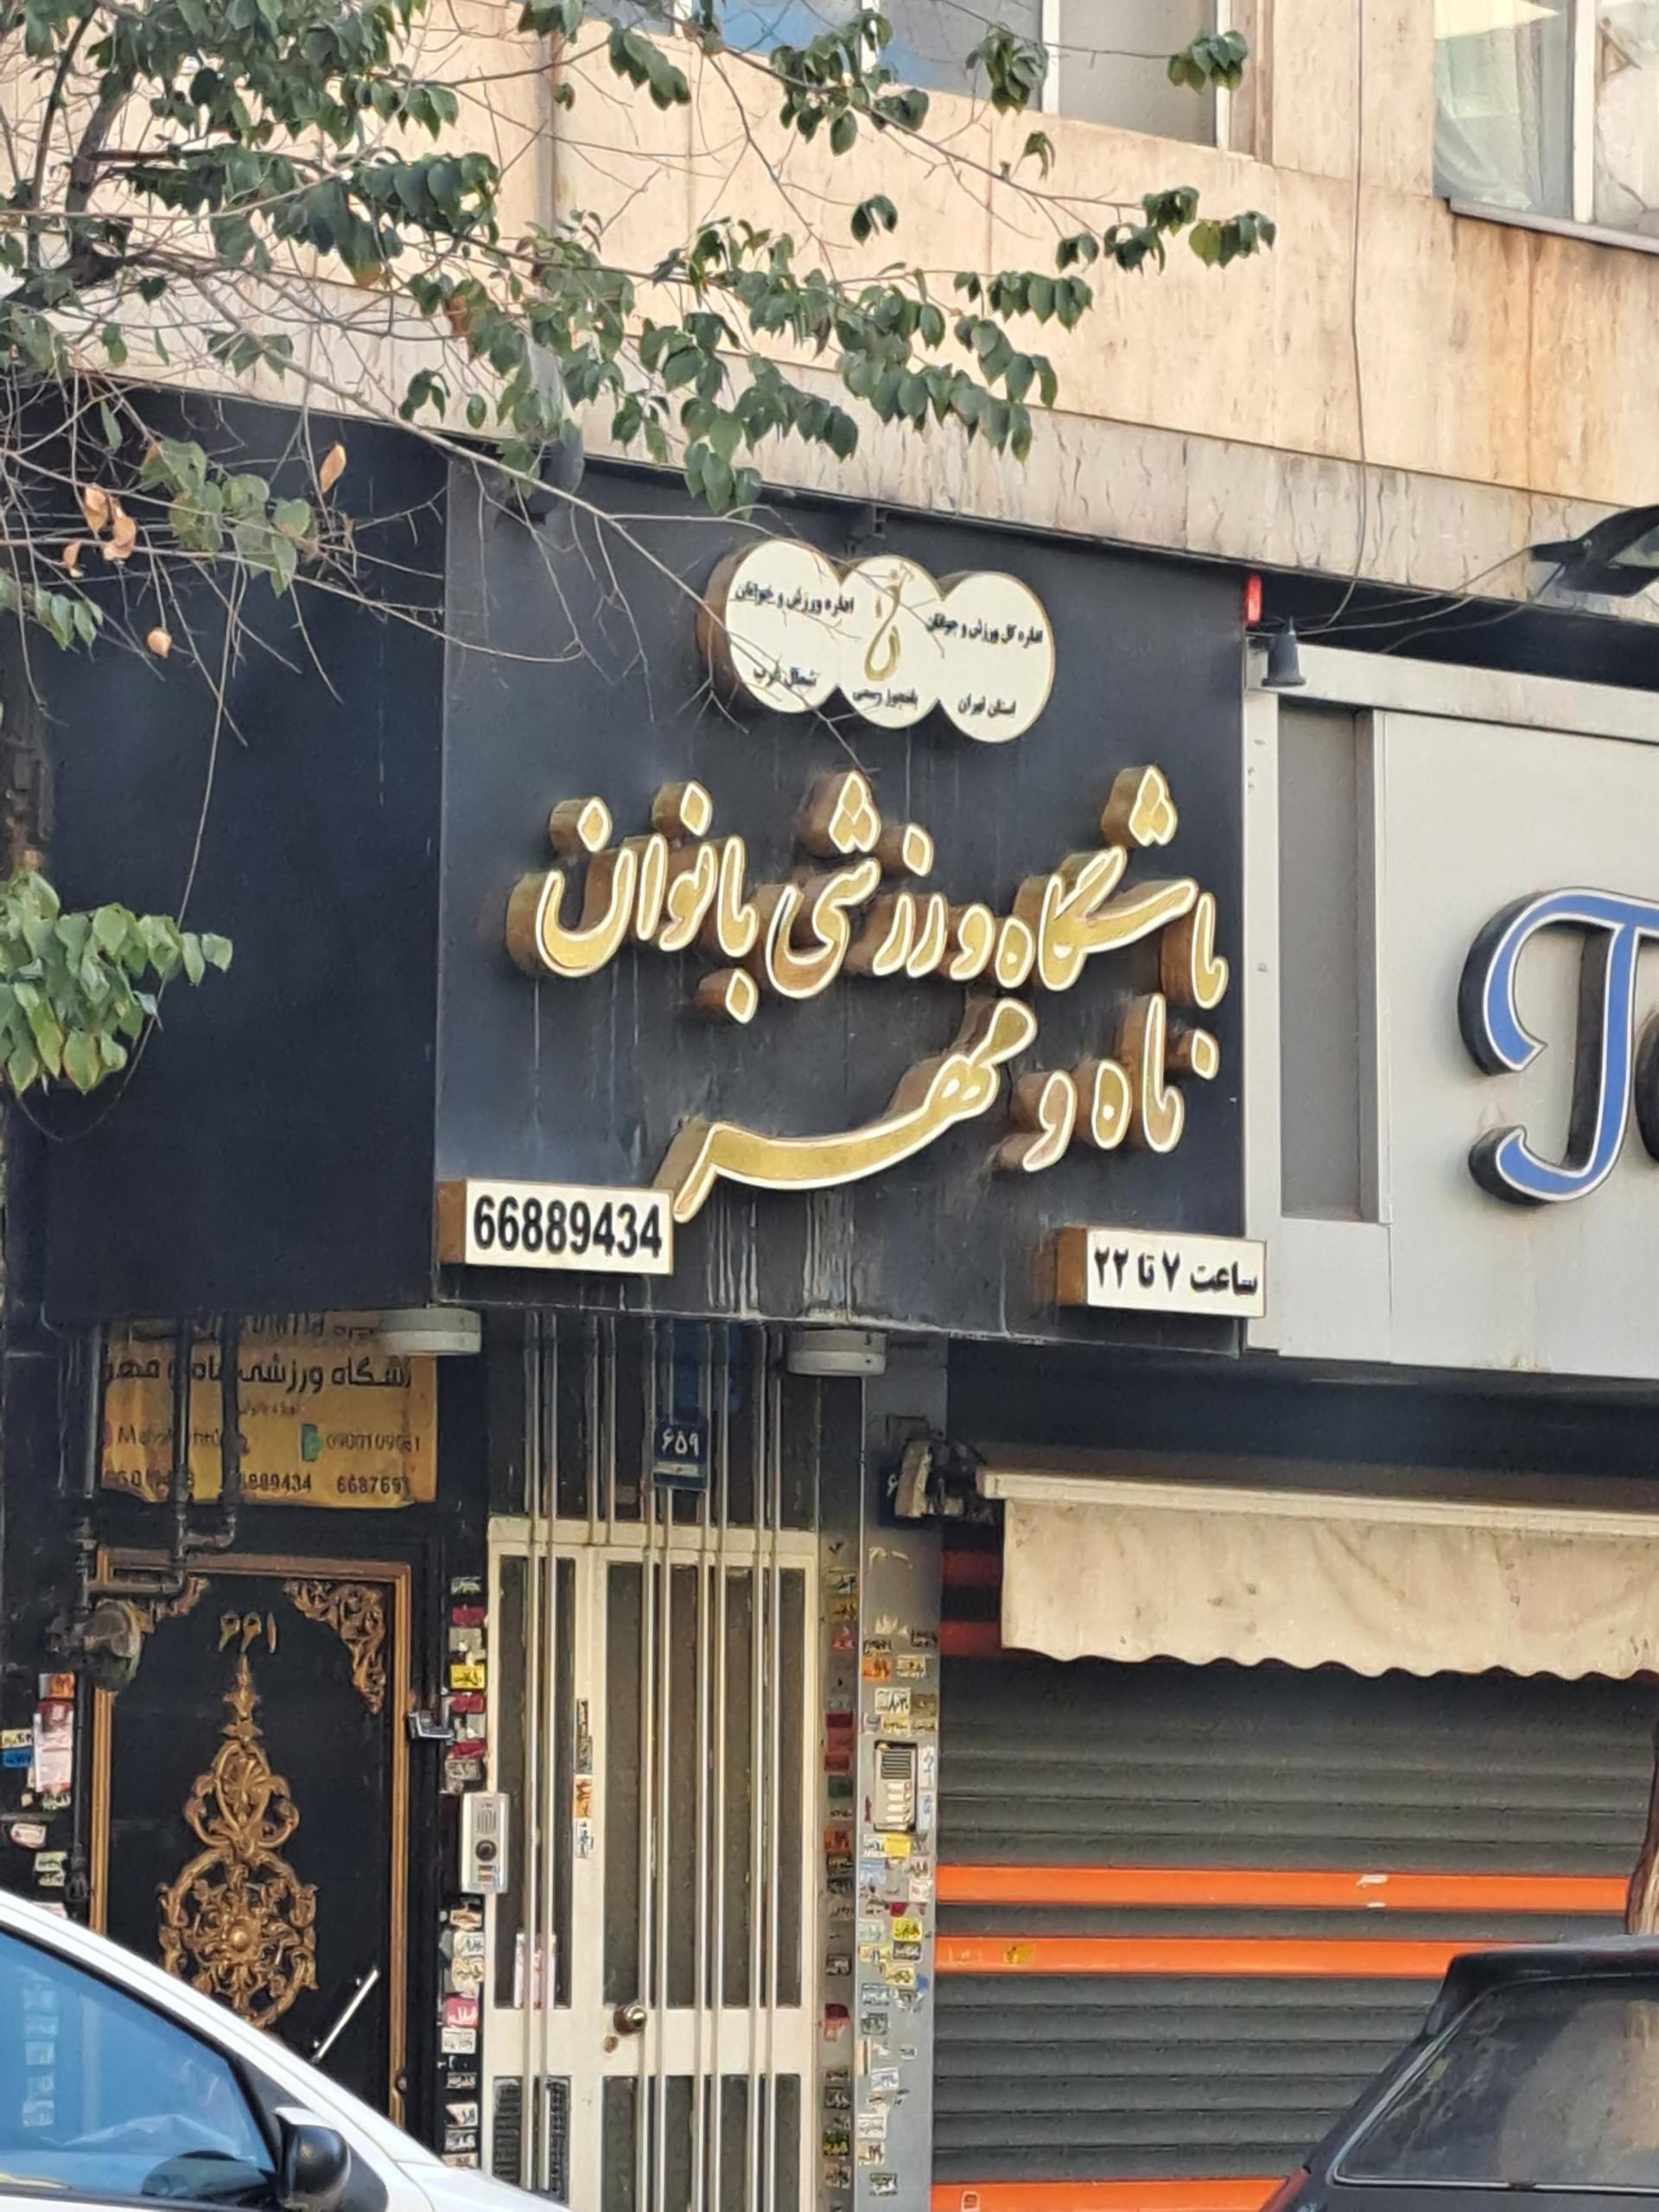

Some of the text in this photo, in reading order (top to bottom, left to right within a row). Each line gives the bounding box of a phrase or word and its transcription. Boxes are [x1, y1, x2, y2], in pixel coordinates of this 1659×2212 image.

[536, 765, 1228, 1079] باشگاه ورزشی بانوان
[673, 992, 1185, 1224] ماه و مهر
[473, 1193, 663, 1259] 66889434
[1094, 1245, 1258, 1297] ساعت ۷ تا ۲۲
[331, 1355, 412, 1389] اشگاه
[661, 1427, 700, 1459] ۶۵۹
